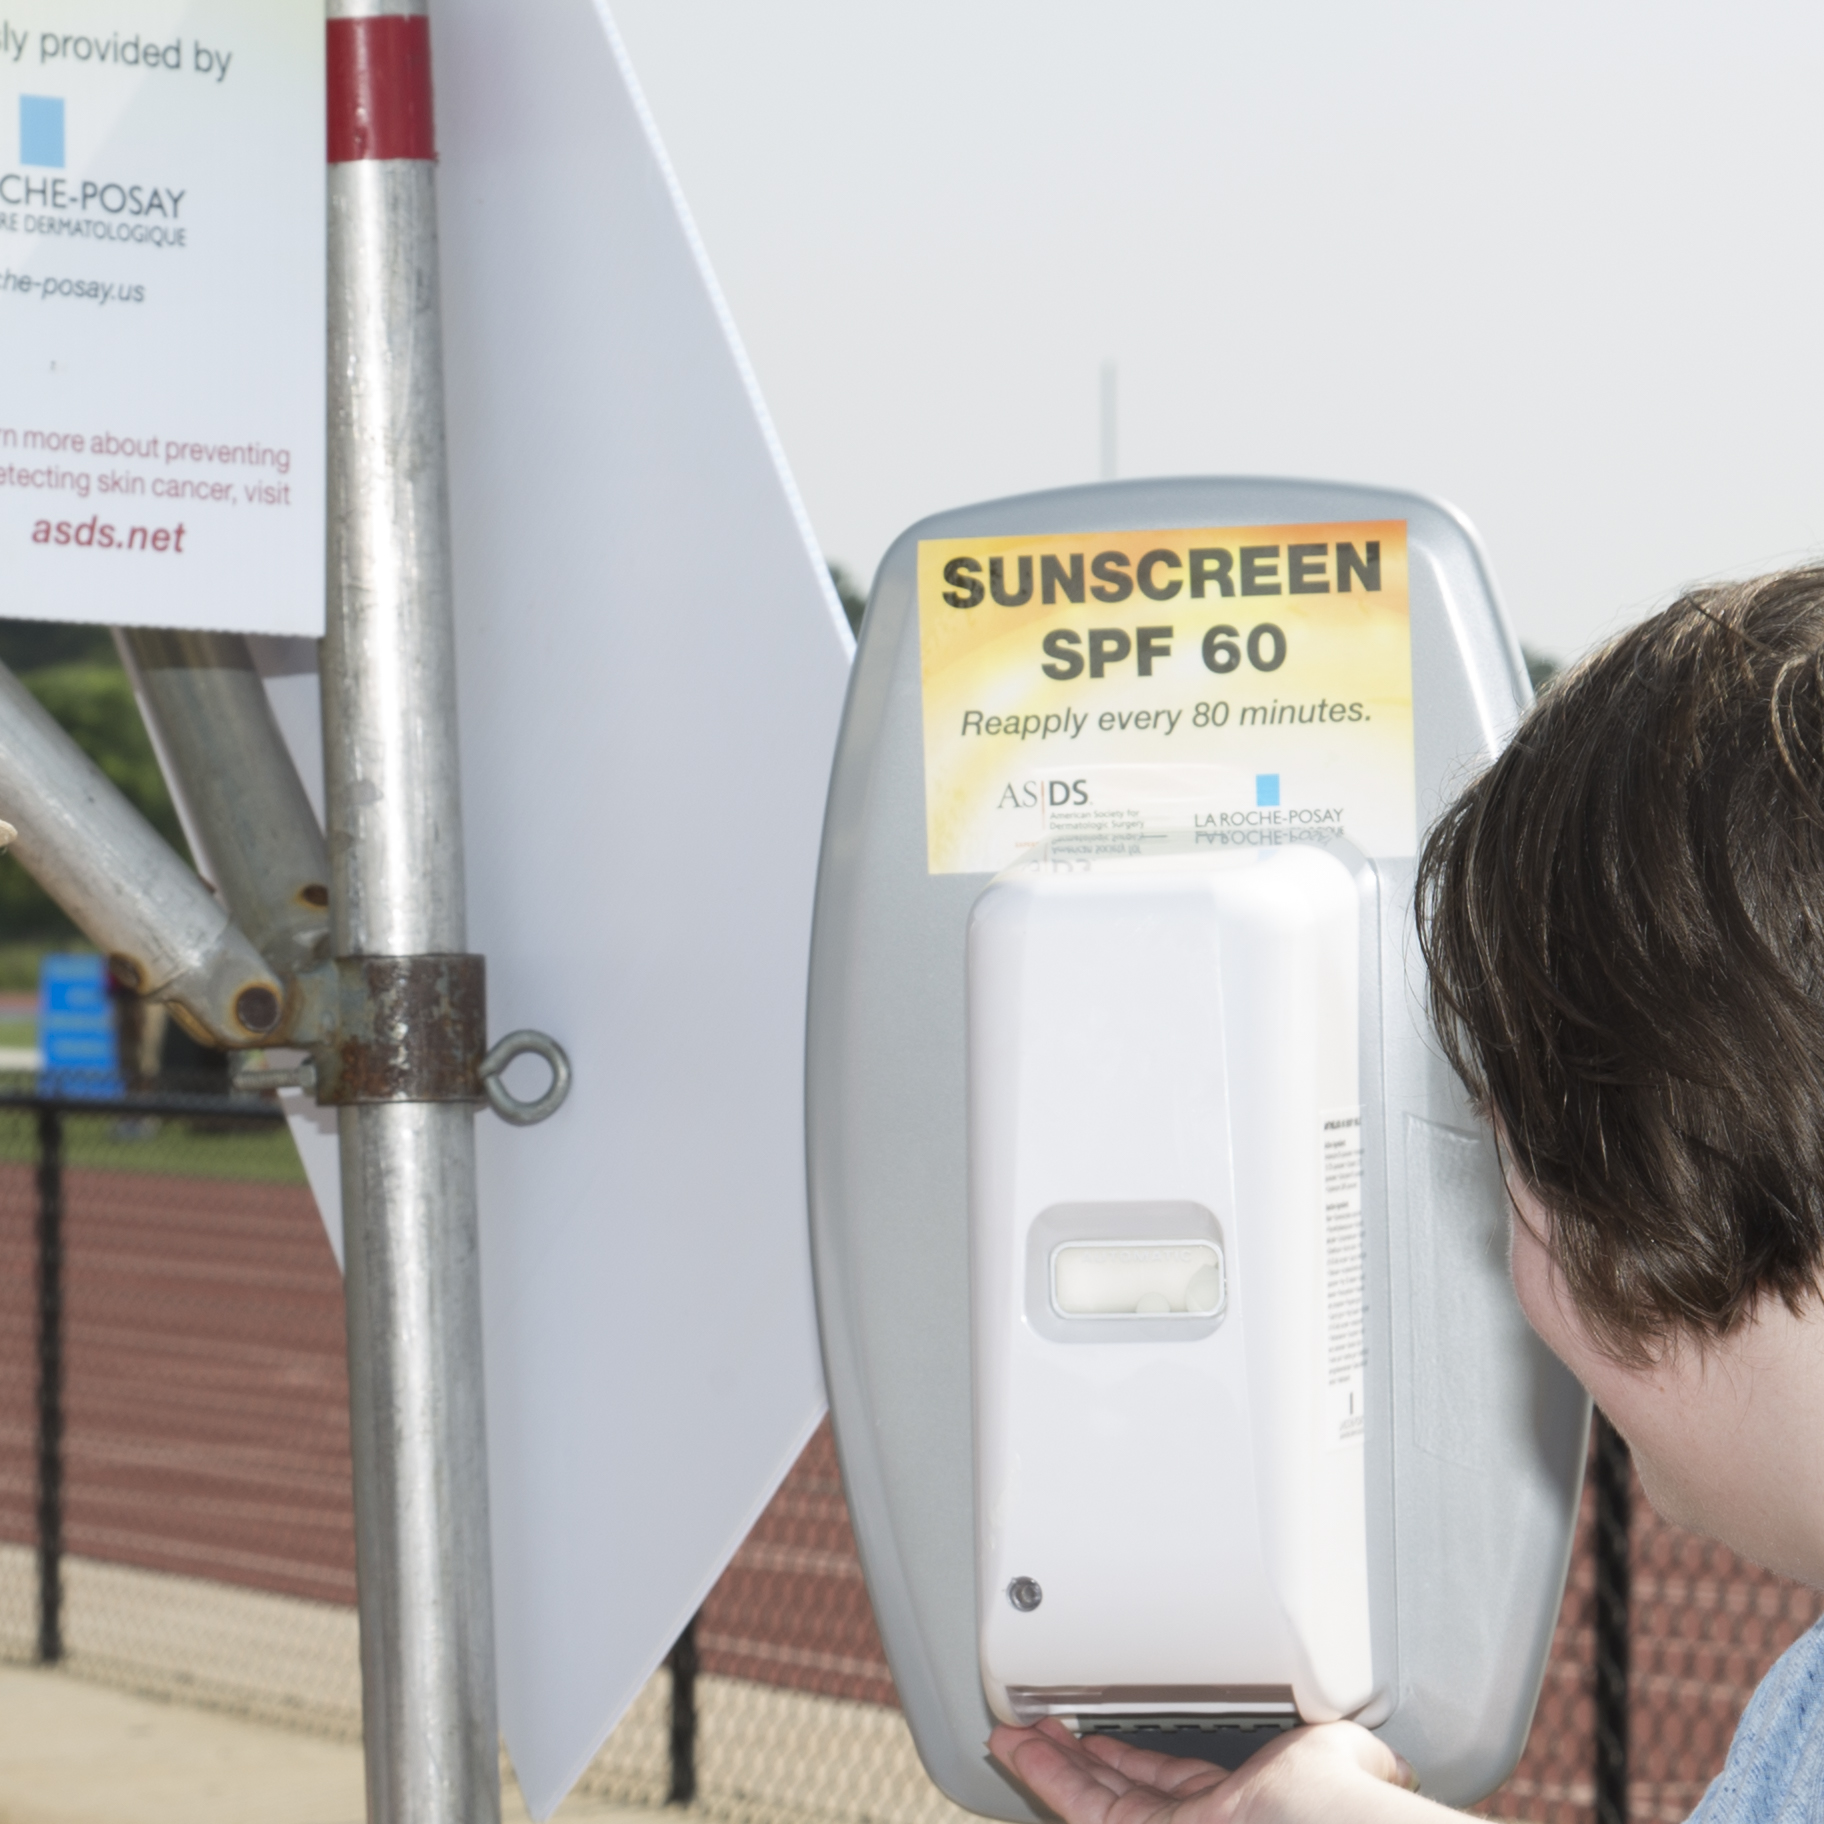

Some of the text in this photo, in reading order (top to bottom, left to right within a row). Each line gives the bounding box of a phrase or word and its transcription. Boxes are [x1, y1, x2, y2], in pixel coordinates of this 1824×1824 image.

[40, 31, 182, 69] provided
[194, 40, 233, 83] by
[25, 214, 186, 248] DERMATOLOGIQUE
[23, 428, 85, 454] more
[90, 431, 160, 459] about
[165, 437, 291, 475] preventing
[97, 469, 145, 496] skin
[151, 476, 238, 506] cancer,
[244, 480, 291, 505] visit
[31, 514, 186, 553] asds.net
[942, 540, 1382, 609] SUNSCREEN
[1041, 622, 1287, 681] SPF 60
[961, 698, 1372, 740] Reapply every 80 minutes.
[1049, 819, 1145, 830] Dermatologic Surgery
[1050, 808, 1139, 820] American Society for
[1194, 808, 1344, 828] LA ROCHE-POSAY
[1081, 1249, 1193, 1264] AUTOMATIC
